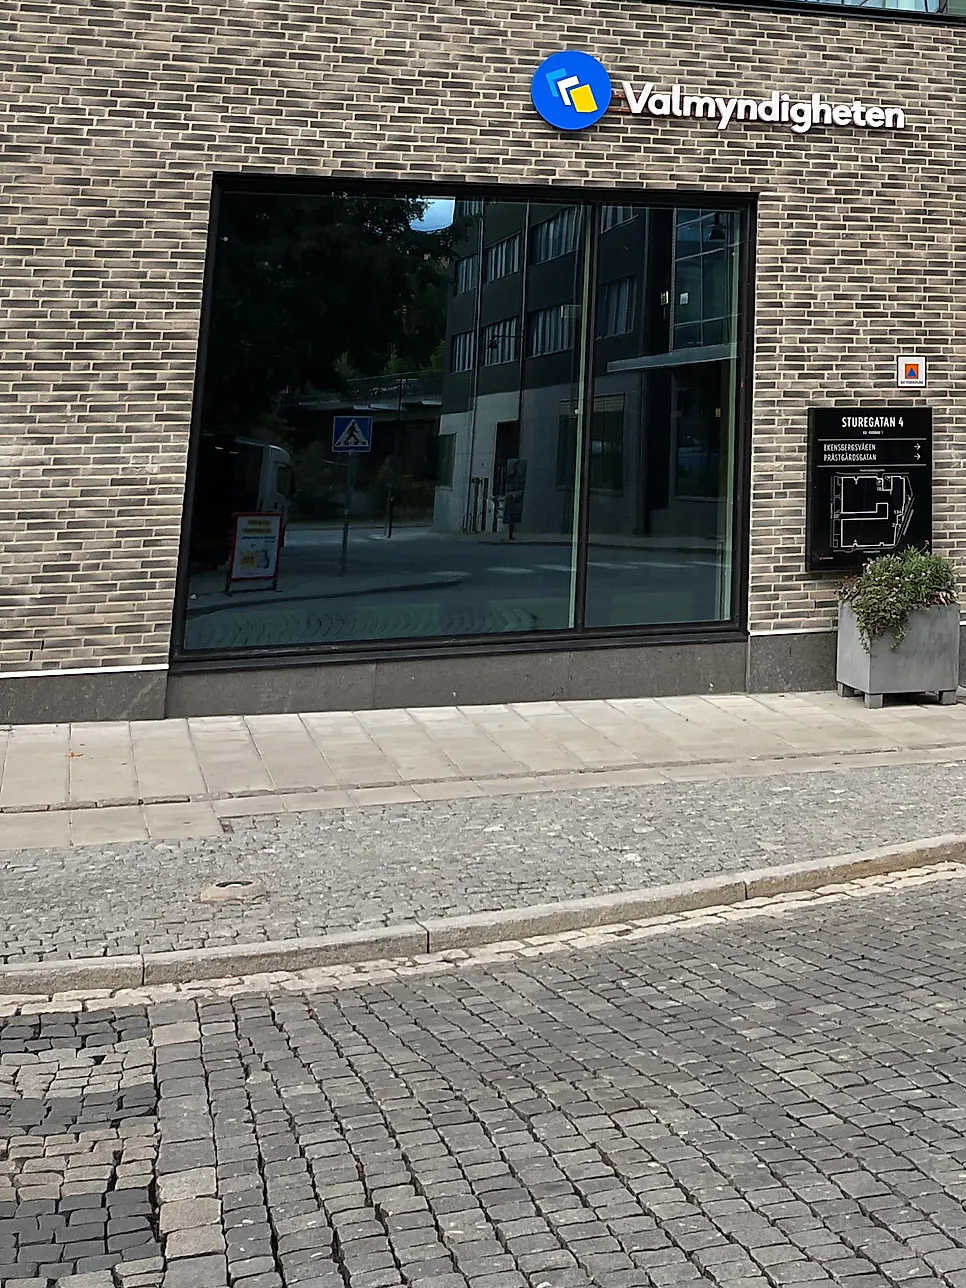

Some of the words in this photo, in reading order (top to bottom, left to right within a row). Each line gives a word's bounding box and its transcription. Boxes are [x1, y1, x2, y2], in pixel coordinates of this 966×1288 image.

[622, 81, 905, 132] Valmyndigheten
[841, 416, 896, 428] STUREGATAN
[898, 416, 904, 428] 4
